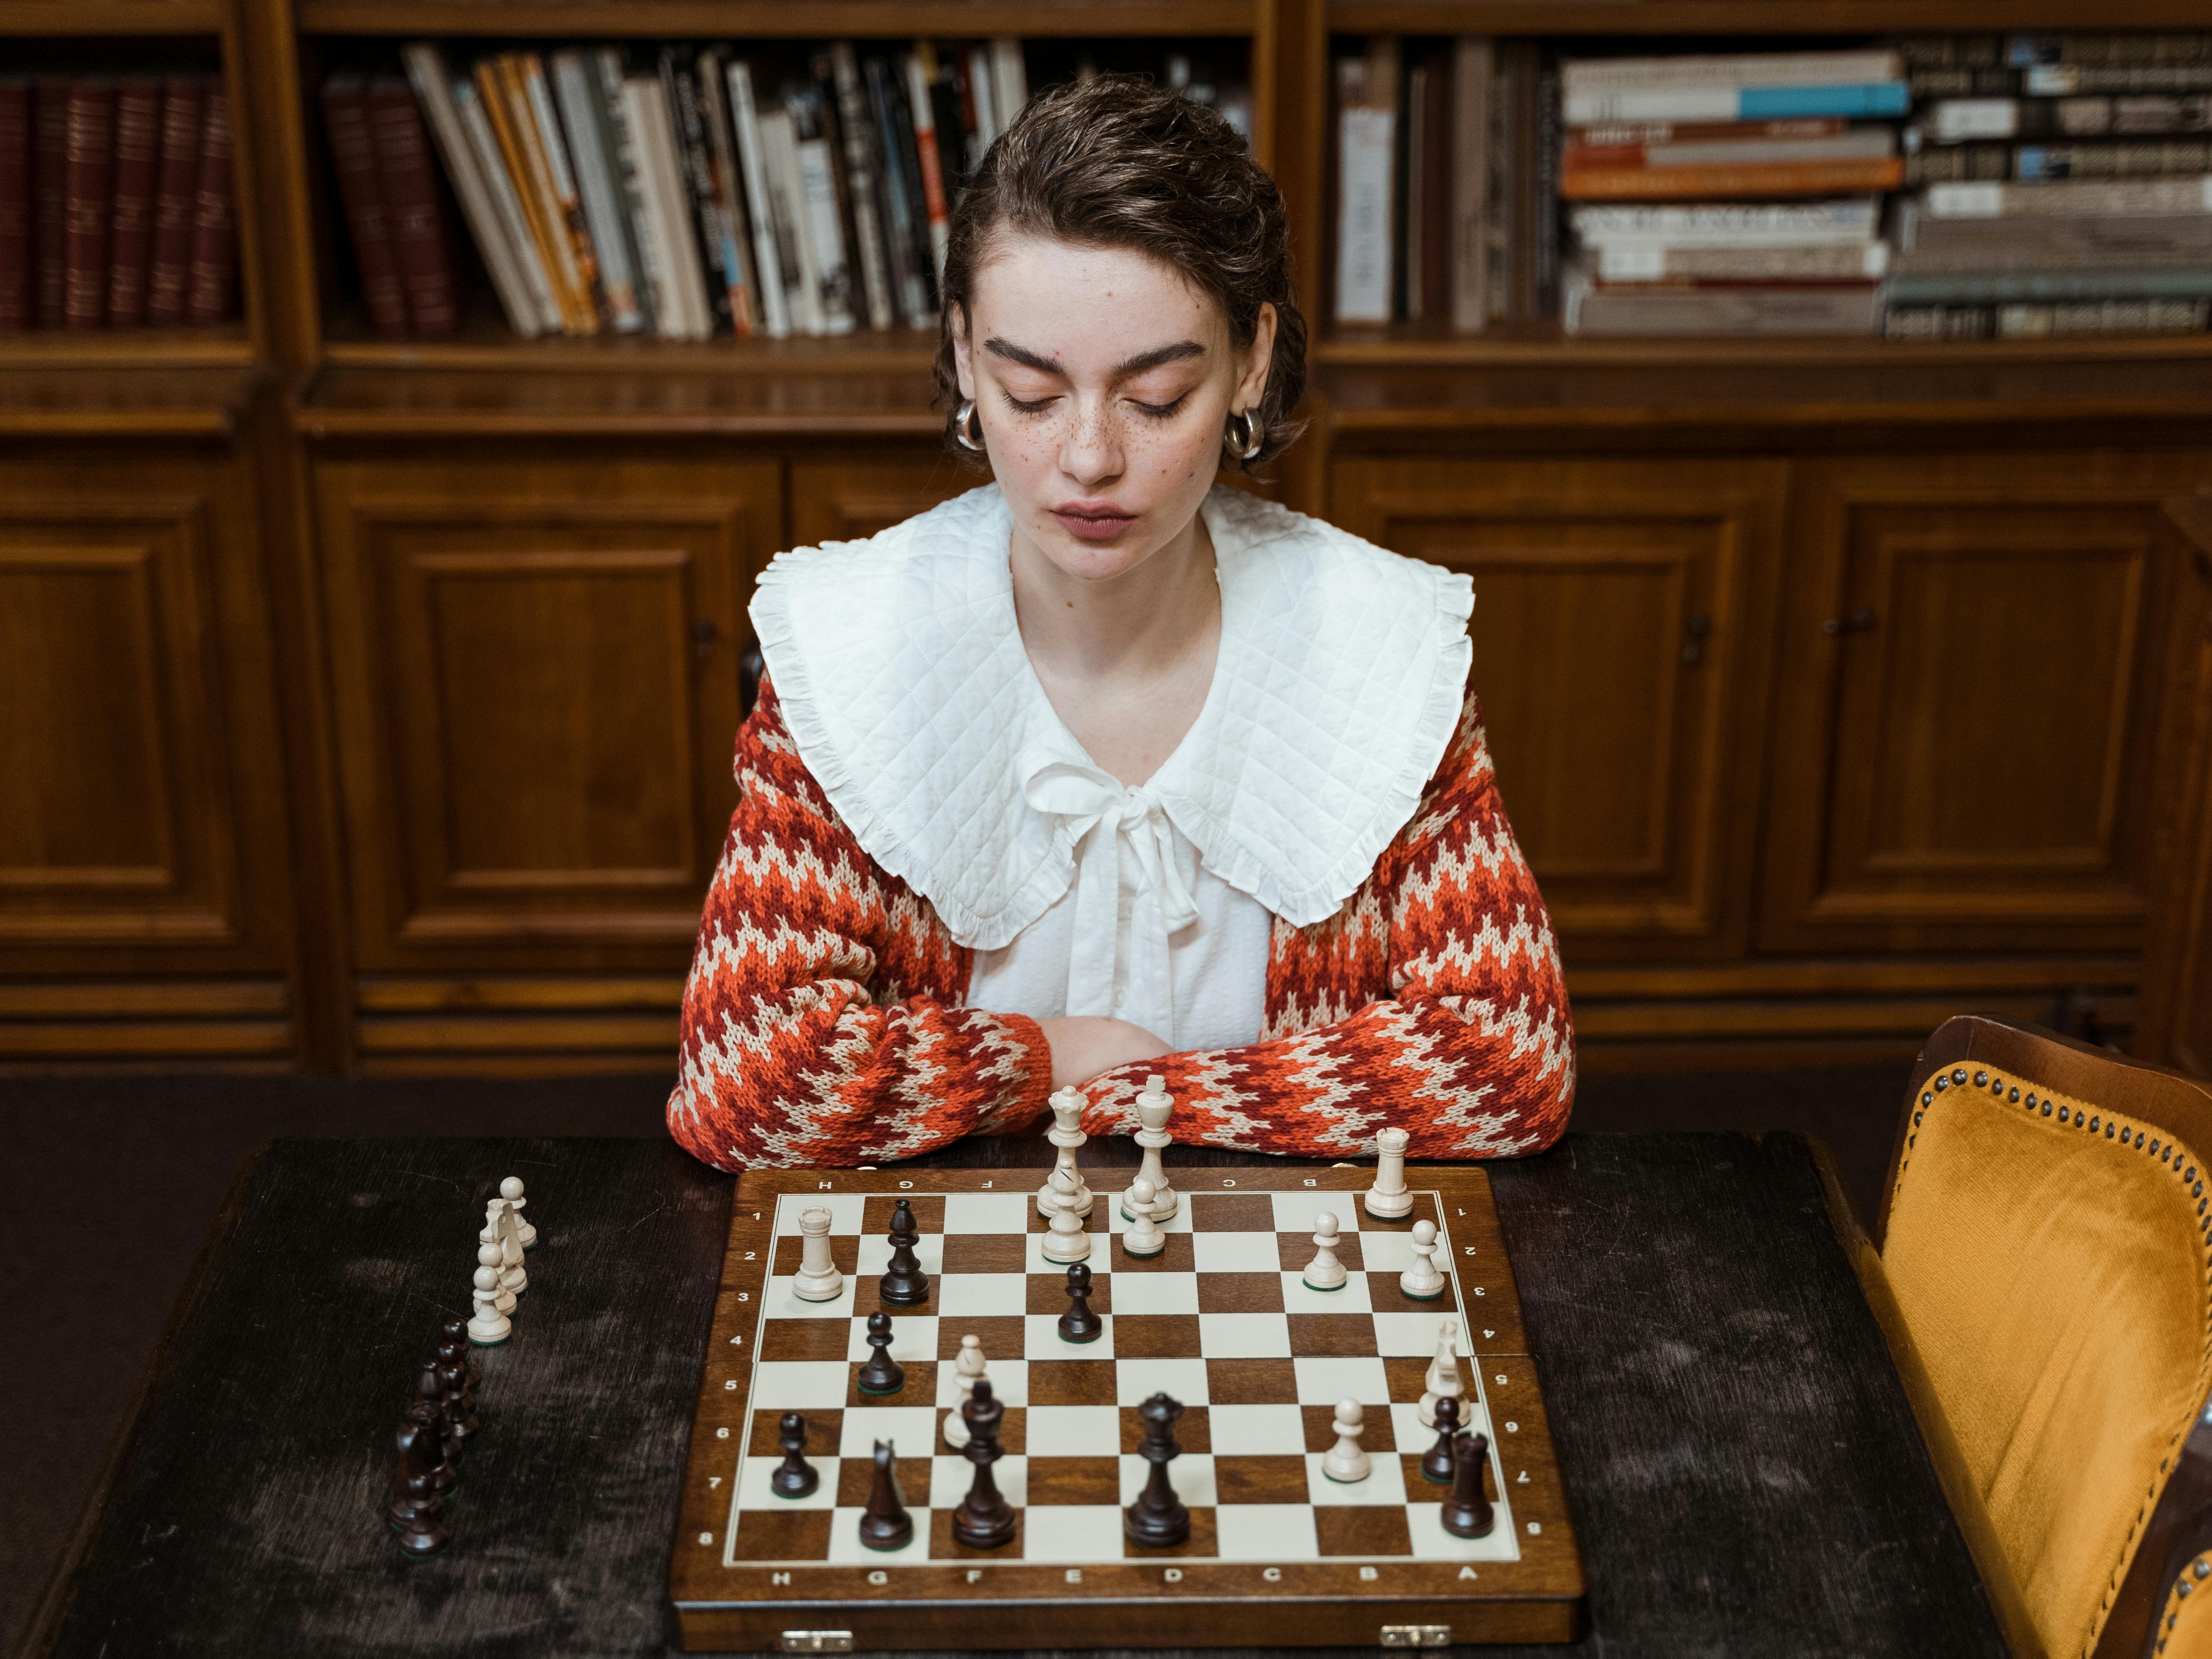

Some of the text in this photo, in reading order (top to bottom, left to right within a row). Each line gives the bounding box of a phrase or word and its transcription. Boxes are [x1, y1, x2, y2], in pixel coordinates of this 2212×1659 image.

[744, 1251, 756, 1260] 2
[1464, 1247, 1476, 1255] 2
[737, 1292, 749, 1302] 3
[1474, 1287, 1485, 1296] 3
[1483, 1329, 1495, 1338] 4
[730, 1335, 742, 1345] 4
[724, 1380, 737, 1390] 5
[1495, 1374, 1508, 1385] 5
[1505, 1421, 1518, 1433] 6
[716, 1427, 729, 1439] 6
[1517, 1470, 1530, 1483] 7
[709, 1477, 722, 1489] 7
[1527, 1522, 1541, 1535] 8
[698, 1532, 713, 1546] 8
[772, 1566, 1477, 1585] H G F E D C B A
